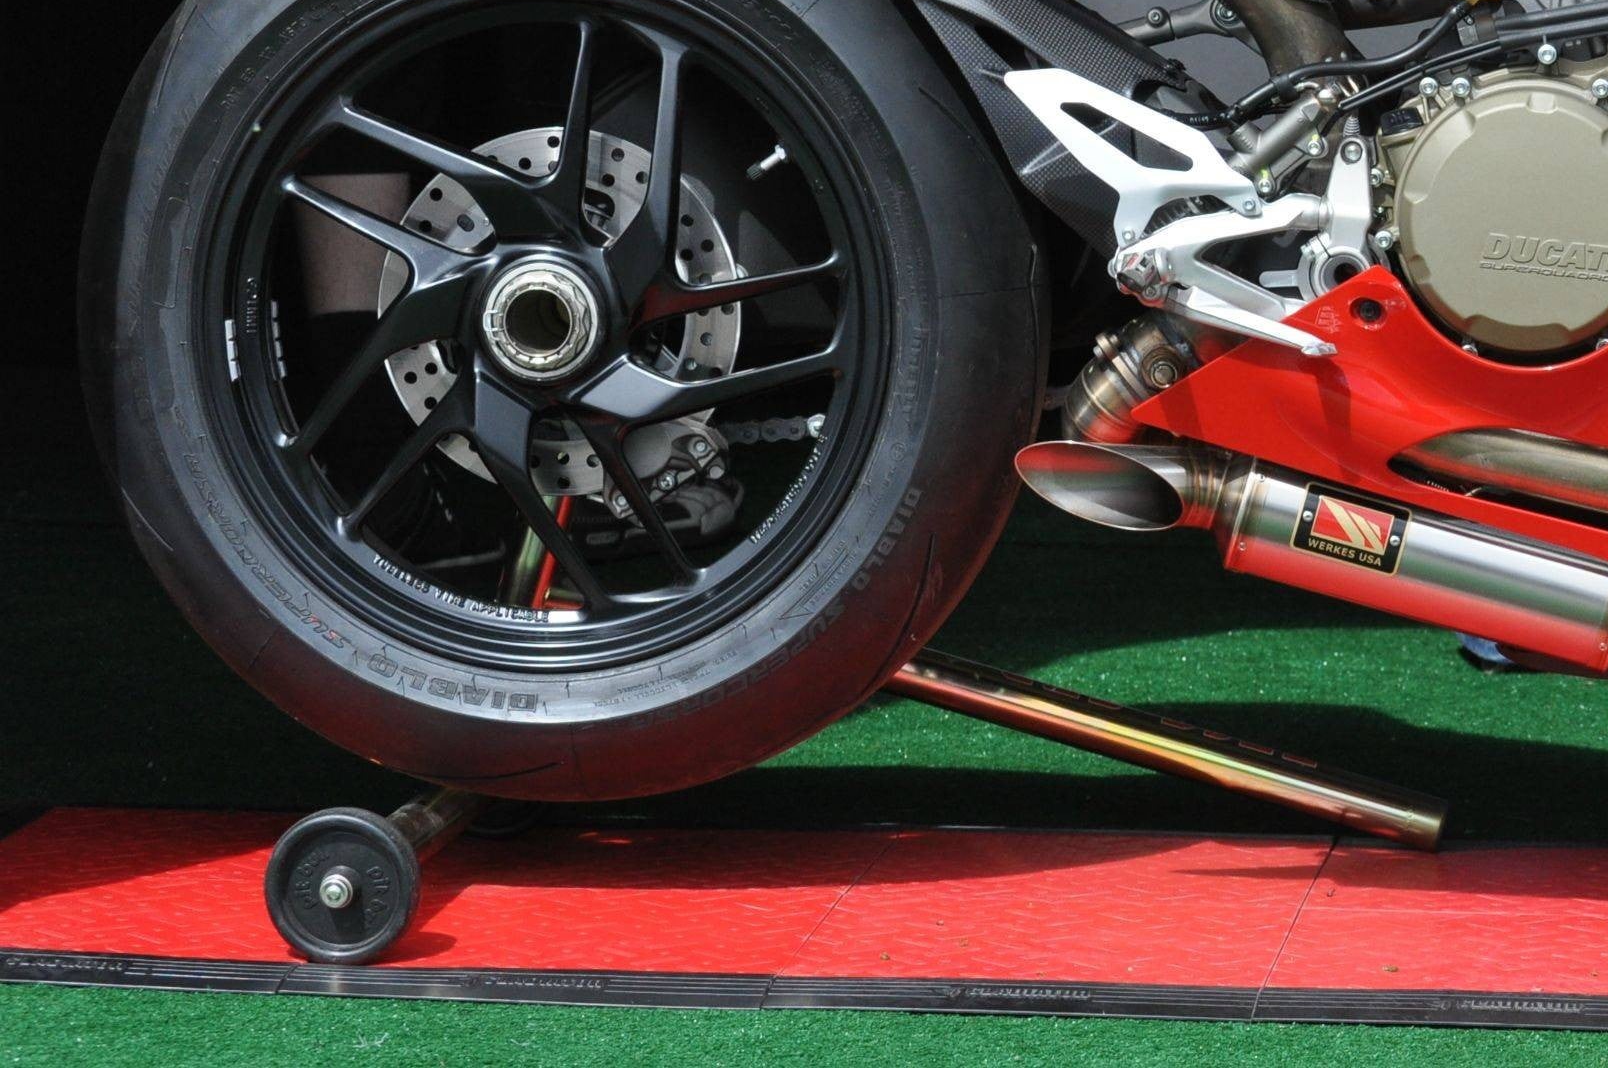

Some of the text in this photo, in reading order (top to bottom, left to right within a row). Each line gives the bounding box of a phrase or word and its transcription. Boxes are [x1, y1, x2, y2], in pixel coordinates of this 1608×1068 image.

[1308, 538, 1381, 566] WERKES USA
[471, 600, 549, 624] APPLICABLE
[367, 653, 539, 713] DIABLO
